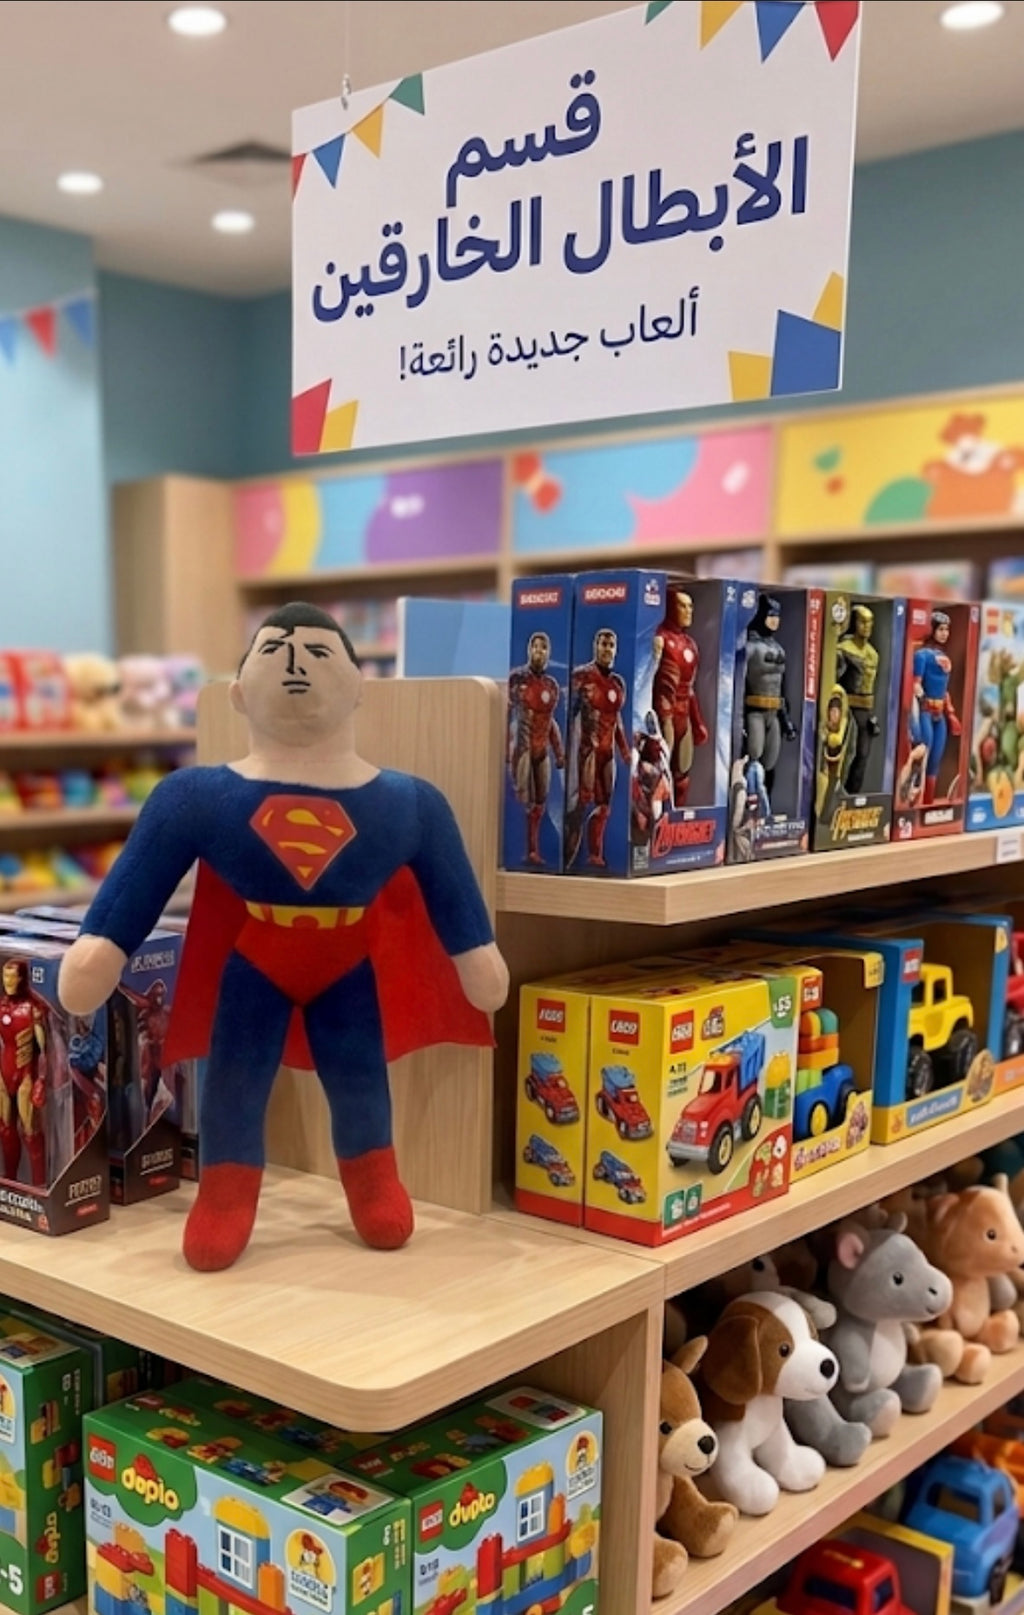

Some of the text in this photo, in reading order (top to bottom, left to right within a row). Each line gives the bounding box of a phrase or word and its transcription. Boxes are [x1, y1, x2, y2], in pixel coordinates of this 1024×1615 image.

[446, 69, 602, 208] قسم
[312, 132, 809, 323] الأبطال الخارقين
[399, 286, 700, 381] ألعاب جديدة رائعة!
